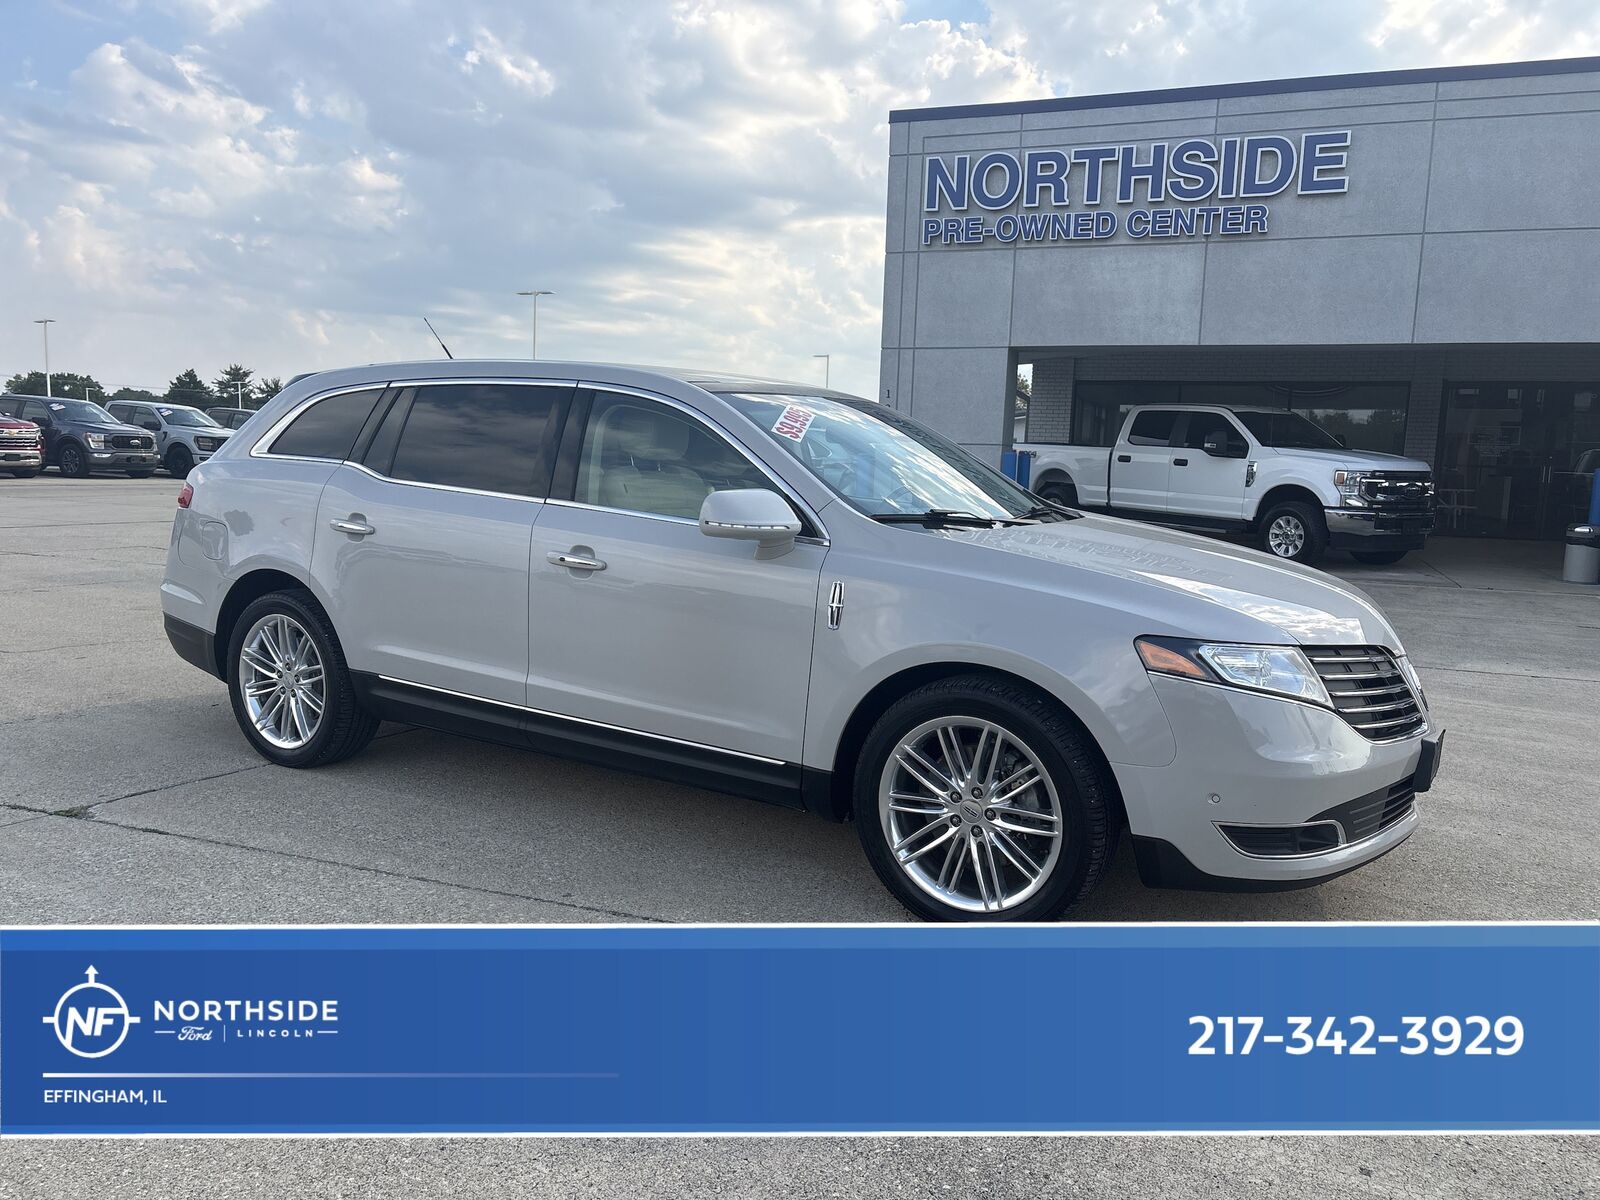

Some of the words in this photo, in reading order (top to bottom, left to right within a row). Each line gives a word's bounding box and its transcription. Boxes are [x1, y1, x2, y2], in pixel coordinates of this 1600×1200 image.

[923, 130, 1352, 212] NORTHSIDE
[923, 210, 1118, 246] PRE-OWNED
[1125, 204, 1270, 238] CENTER
[774, 405, 813, 441] $9,995
